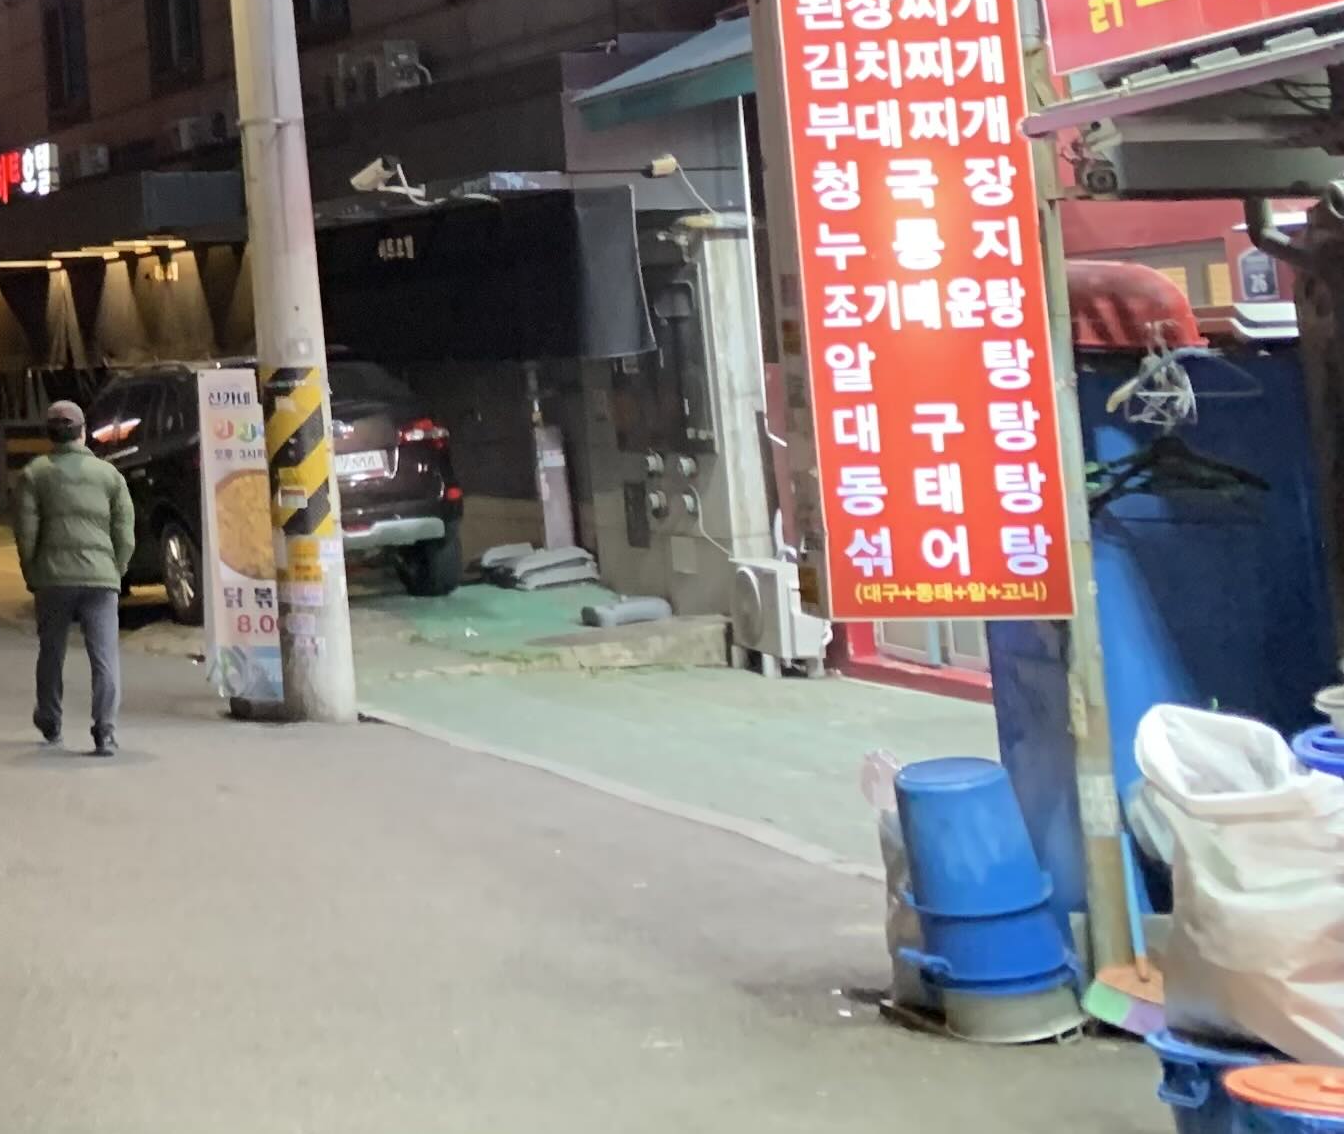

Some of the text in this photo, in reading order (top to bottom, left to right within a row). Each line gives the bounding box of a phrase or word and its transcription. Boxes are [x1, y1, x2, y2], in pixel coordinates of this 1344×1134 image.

[802, 36, 1005, 89] 김치찌개
[805, 99, 1012, 149] 부대찌개
[811, 159, 1016, 212] 청국장
[823, 277, 1027, 331] 조기매운탕
[833, 400, 1040, 454] 대구탕
[836, 461, 1047, 515] 동태탕
